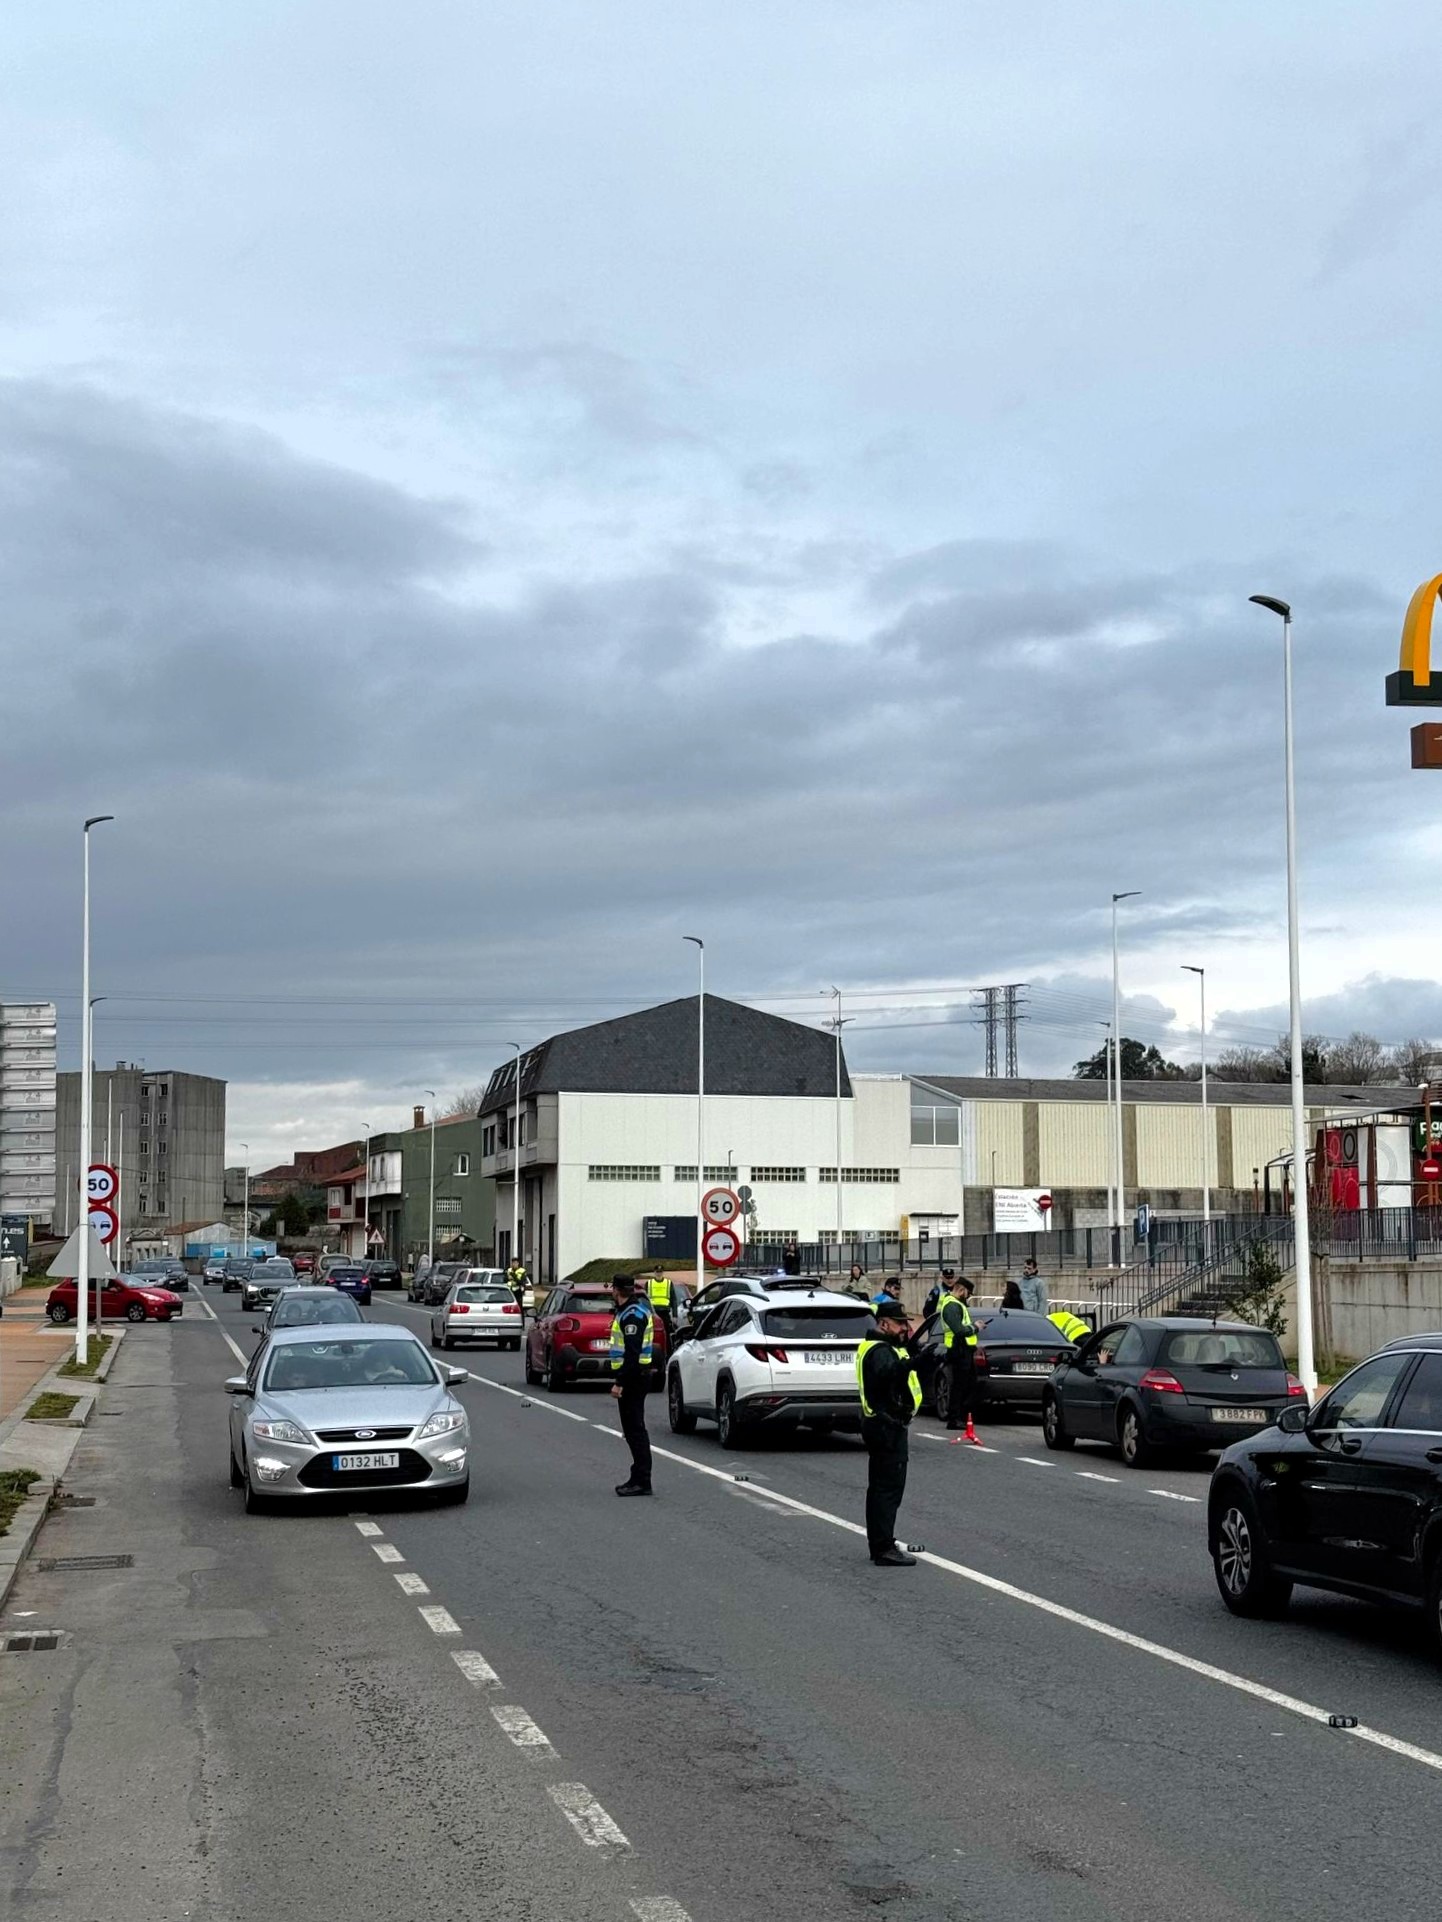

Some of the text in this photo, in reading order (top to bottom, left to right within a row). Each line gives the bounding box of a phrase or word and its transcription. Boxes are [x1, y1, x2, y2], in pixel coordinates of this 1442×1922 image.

[88, 1178, 109, 1191] 50
[710, 1201, 733, 1214] 50
[811, 1353, 852, 1363] 4433 LRH
[1220, 1409, 1265, 1420] 3882 FPK
[341, 1454, 396, 1469] 0132 HLT
